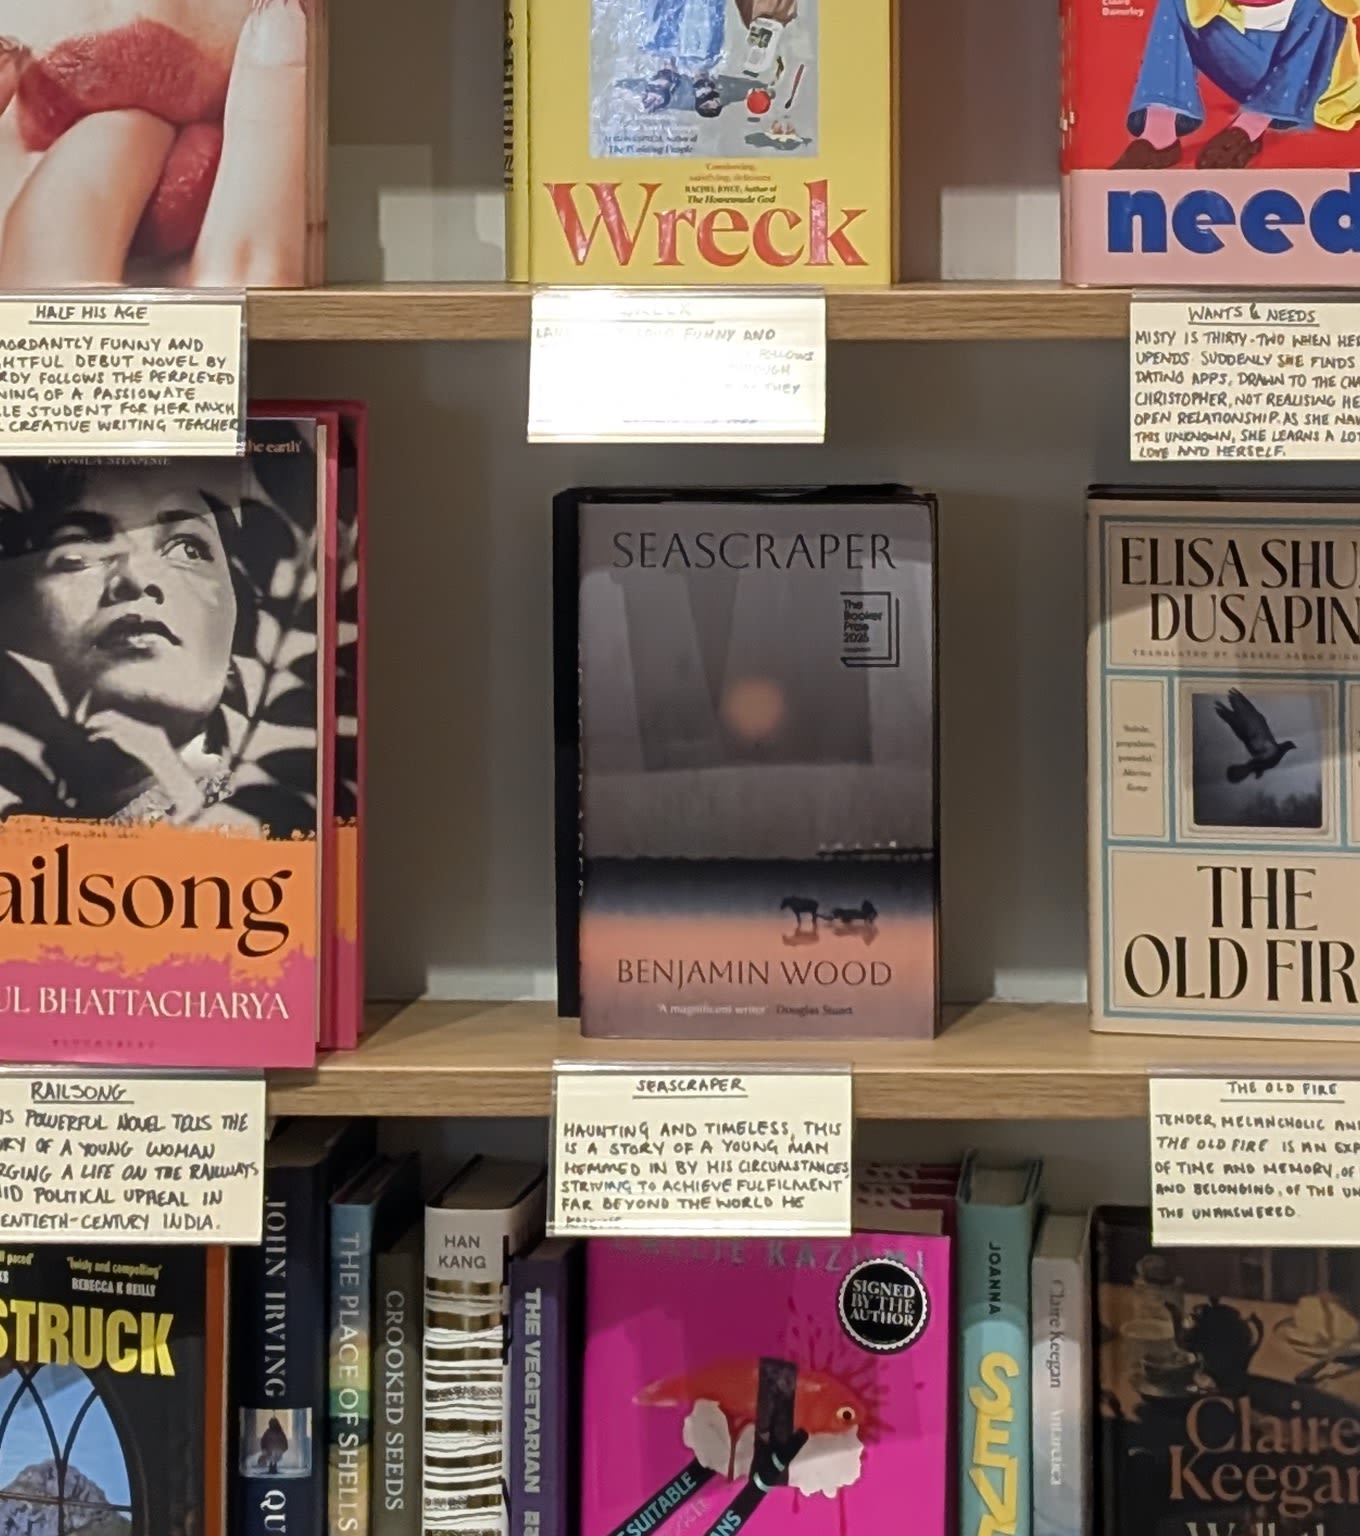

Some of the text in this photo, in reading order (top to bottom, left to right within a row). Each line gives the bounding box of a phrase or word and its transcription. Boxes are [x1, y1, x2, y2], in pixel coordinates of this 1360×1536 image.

[544, 178, 868, 267] Wreck
[36, 305, 148, 319] HALF HIS AGE
[1188, 306, 1242, 321] WANTS
[1266, 309, 1316, 322] NEEDS
[101, 337, 161, 351] FUNNY
[168, 338, 203, 351] AND
[76, 355, 134, 367] DEBUT
[143, 356, 199, 367] NOVEL
[207, 356, 226, 368] BY
[612, 532, 896, 569] SEASCRAPER
[1121, 538, 1248, 588] ELISA
[1150, 593, 1360, 645] DUSAPIN
[1197, 866, 1318, 931] THE
[618, 959, 891, 988] BENJAMIN WOOD
[1124, 933, 1248, 999] OLD
[39, 988, 288, 1020] BHATTACHARYA
[31, 1081, 126, 1100] RAILSONG
[636, 1078, 745, 1092] SEASCRAPER
[564, 1122, 841, 1140] HAUNTING AND TIMELESS, THIS
[444, 1235, 480, 1249] HAN
[439, 1252, 487, 1269] KANG
[265, 1198, 287, 1398] JOHN IRVING
[383, 1290, 405, 1511] CROOKED SEEDS
